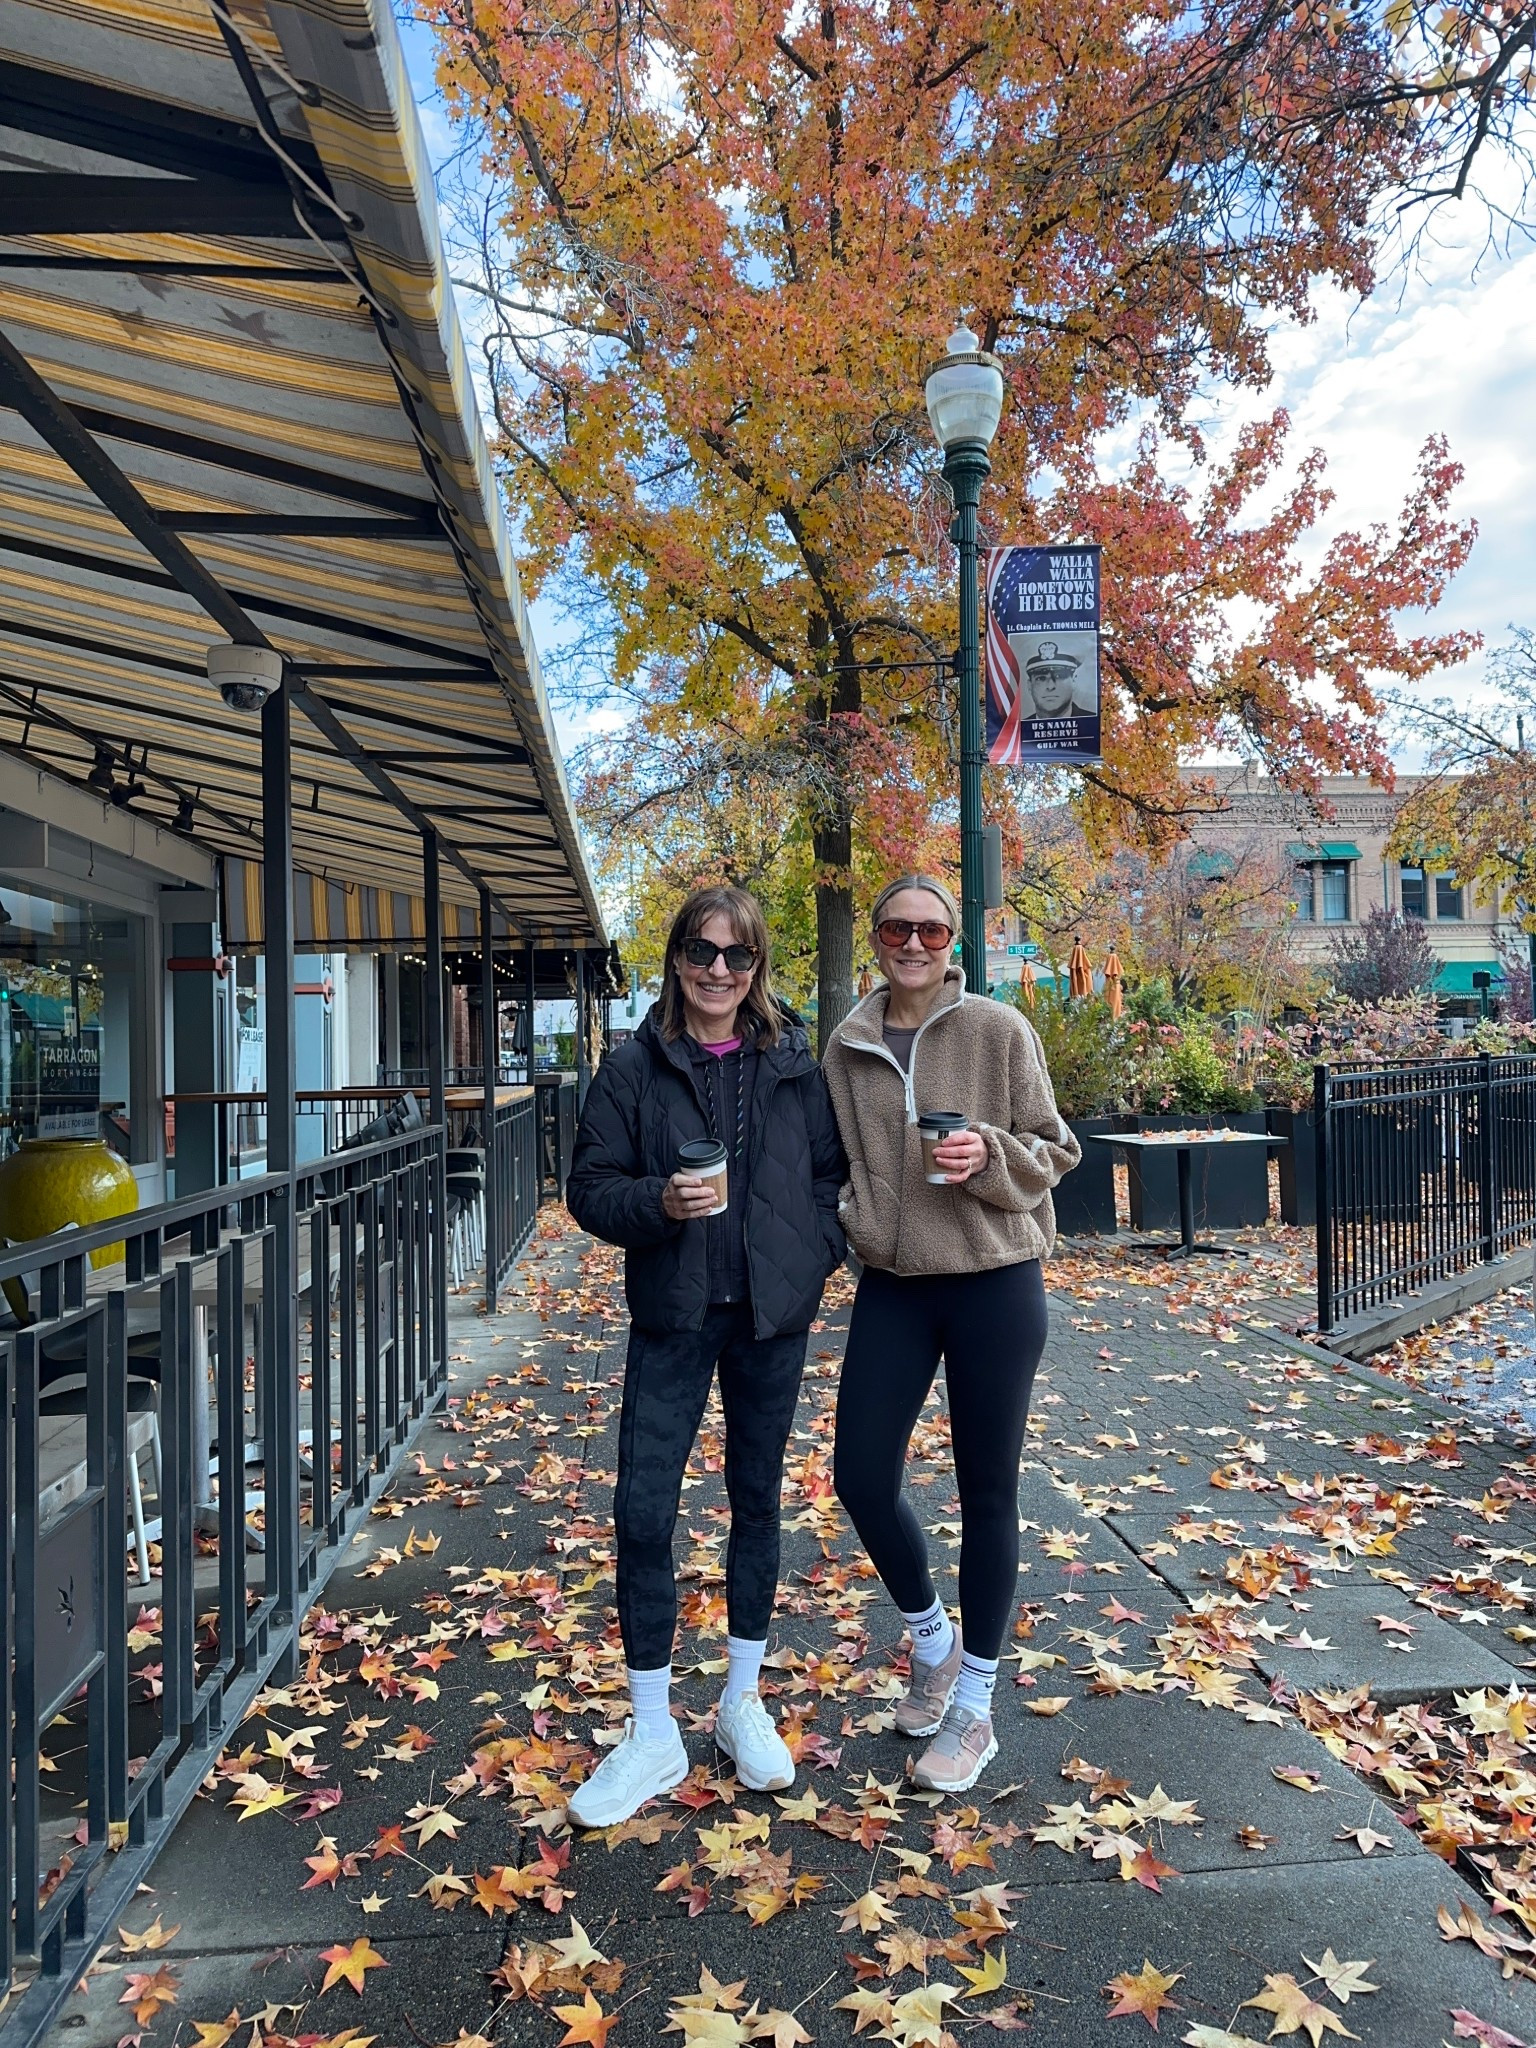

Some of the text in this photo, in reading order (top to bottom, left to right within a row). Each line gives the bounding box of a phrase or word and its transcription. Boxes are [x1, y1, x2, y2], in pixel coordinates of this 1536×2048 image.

[1049, 555, 1094, 568] WALLA
[1049, 567, 1094, 580] WALLA
[1018, 580, 1095, 595] HOMETOWN
[1018, 593, 1094, 612] HEROES
[1016, 624, 1042, 632] Chaplain
[1052, 621, 1078, 630] THOMAS
[1079, 621, 1095, 629] MELE
[1031, 720, 1079, 730] US NAVAL
[1034, 729, 1078, 738] RESERVE
[1036, 740, 1079, 749] GULF WAR
[43, 1047, 98, 1064] TARRAGON
[43, 1068, 98, 1078] NORTHWEST
[72, 1119, 81, 1128] FOR
[82, 1117, 96, 1127] LEASE
[919, 1622, 942, 1636] alo
